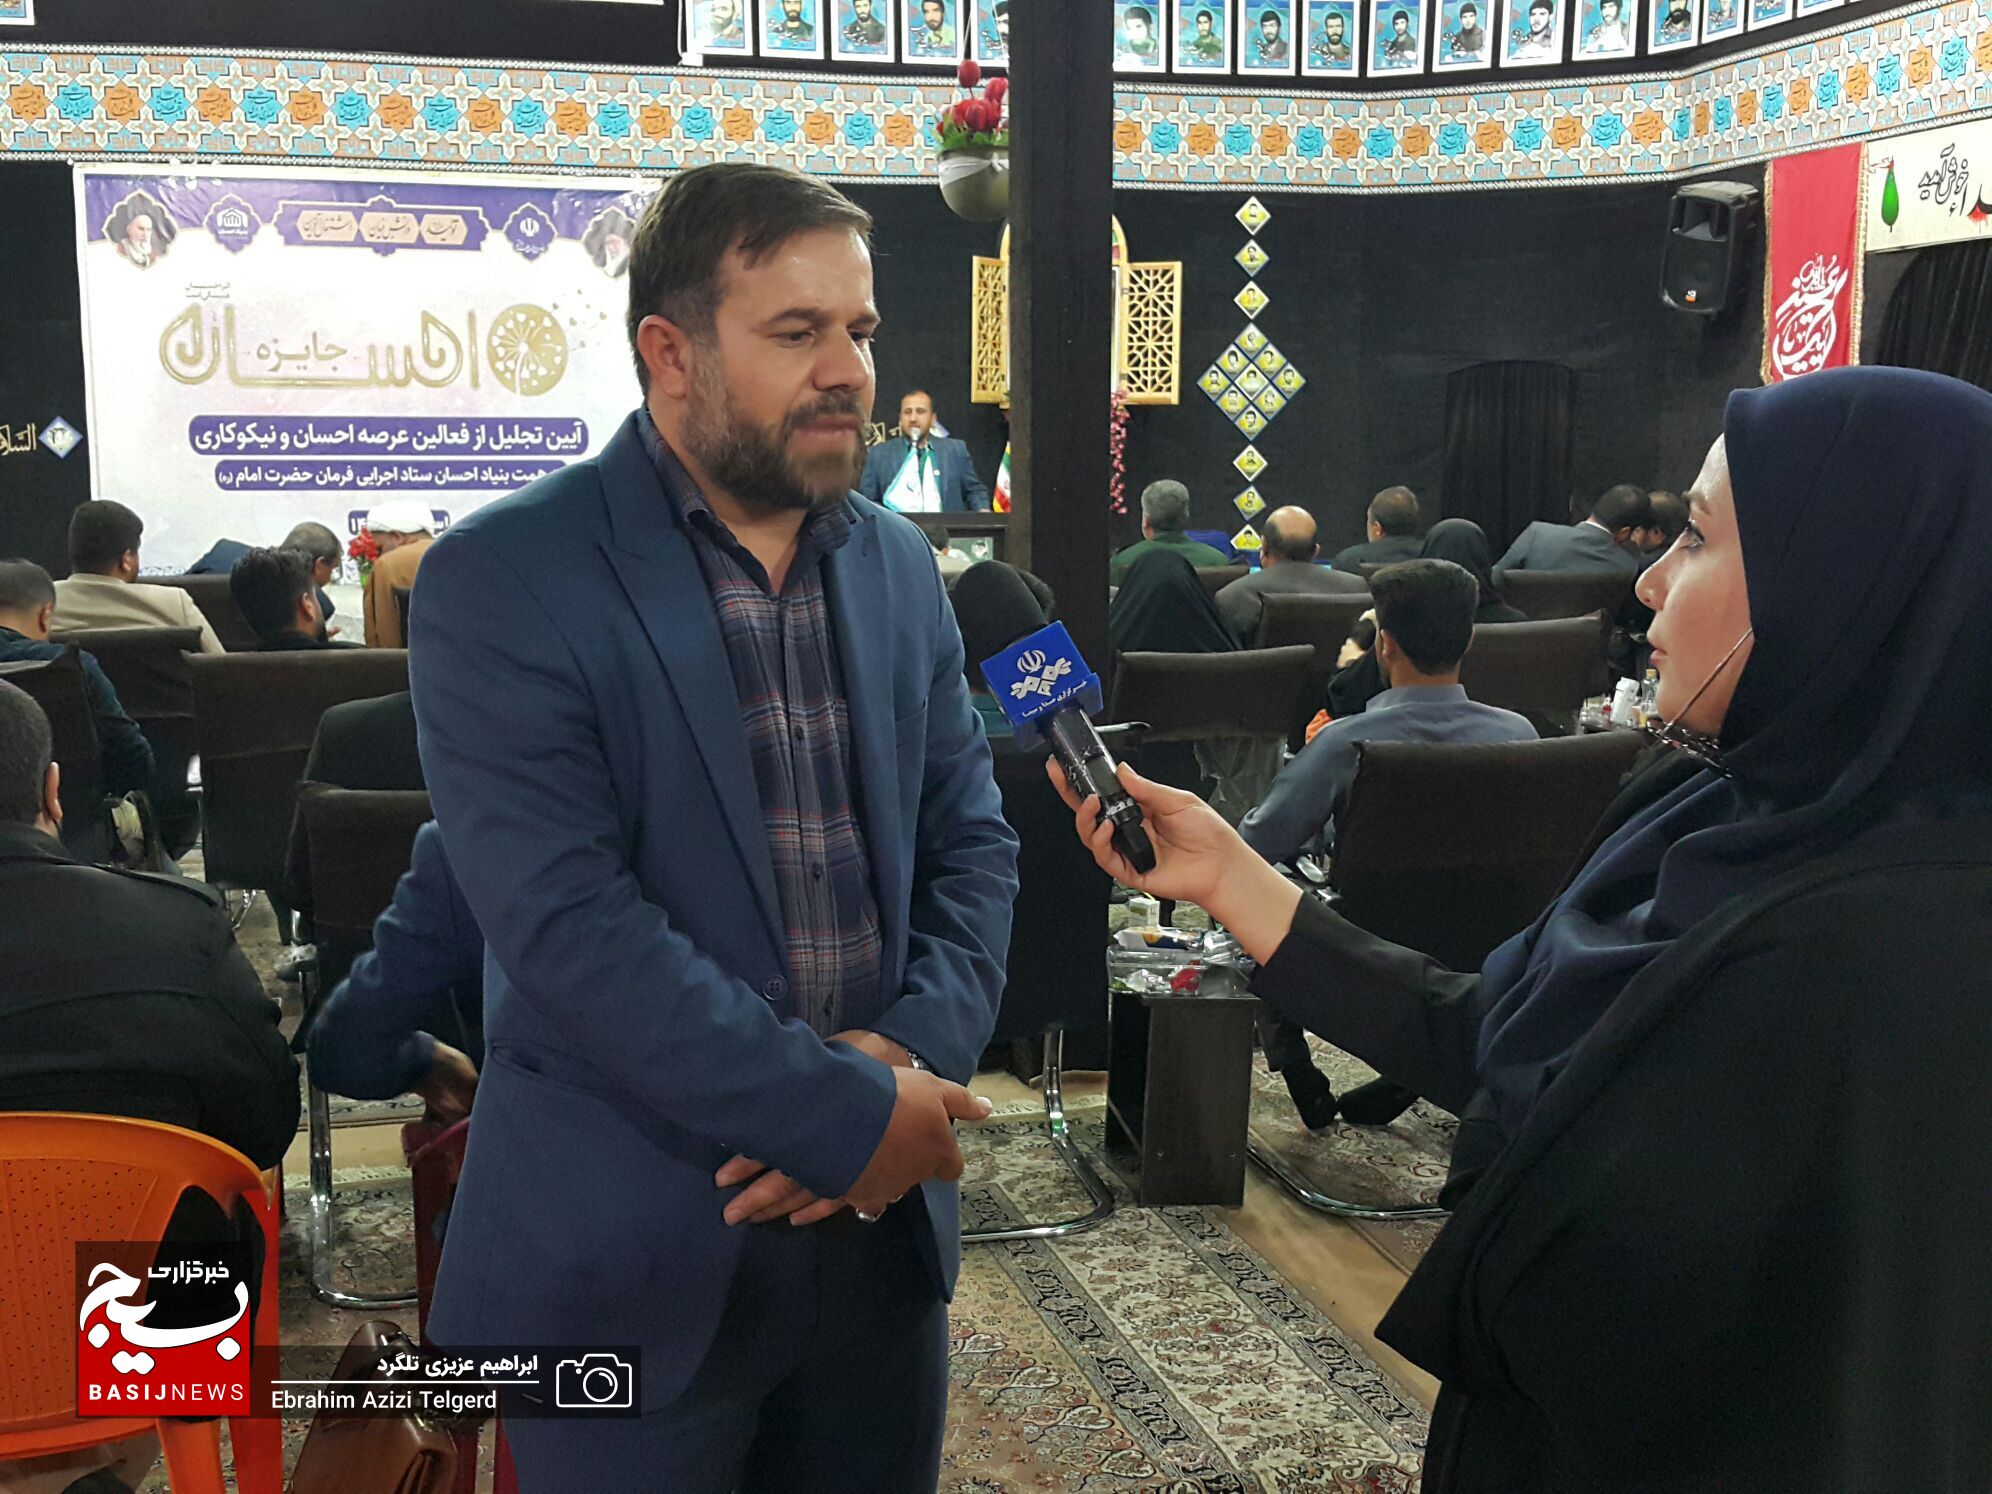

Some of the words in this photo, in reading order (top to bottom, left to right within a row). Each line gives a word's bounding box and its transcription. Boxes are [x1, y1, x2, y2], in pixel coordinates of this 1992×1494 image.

[256, 331, 348, 373] جایزه
[195, 422, 277, 450] نیکوکاری
[279, 430, 290, 450] و
[293, 423, 354, 448] احسان
[357, 429, 409, 451] عرصه
[412, 422, 470, 451] فعالین
[472, 424, 486, 451] از
[489, 424, 543, 450] تجلیل
[545, 421, 583, 451] آیین
[235, 466, 262, 488] امام
[264, 466, 313, 486] حضرت
[315, 465, 354, 486] فرمان
[356, 466, 398, 486] اجرایی
[401, 466, 432, 481] ستاد
[435, 466, 478, 485] احسان
[480, 466, 510, 485] بنیاد
